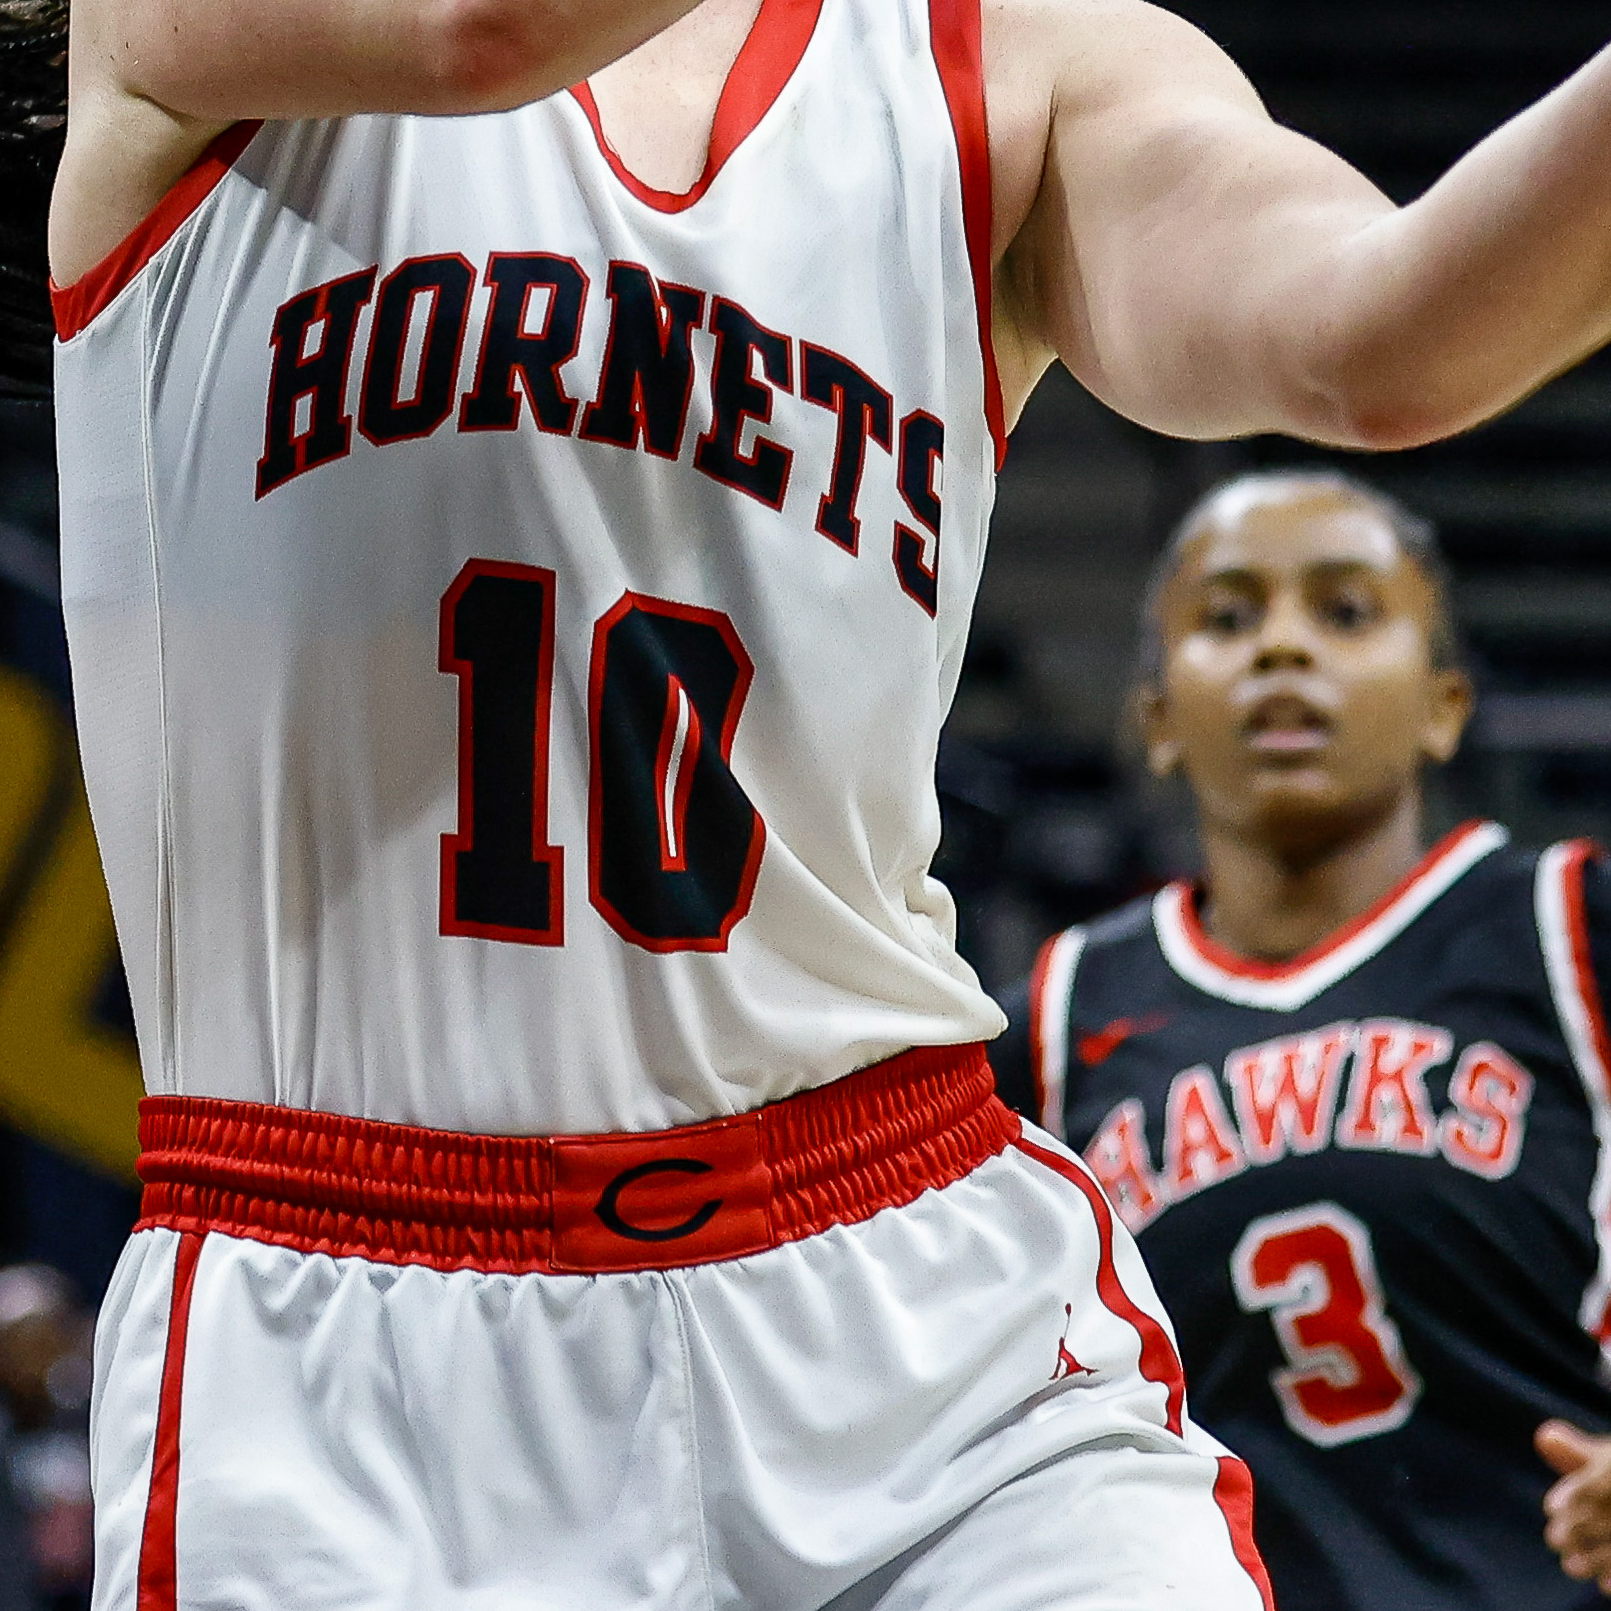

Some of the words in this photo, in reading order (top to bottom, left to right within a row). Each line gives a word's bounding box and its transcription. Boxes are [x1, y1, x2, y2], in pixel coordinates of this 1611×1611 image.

[255, 252, 943, 618] HORNETS
[439, 558, 766, 952] 10
[594, 1159, 723, 1241] C
[1230, 1200, 1424, 1448] 3
